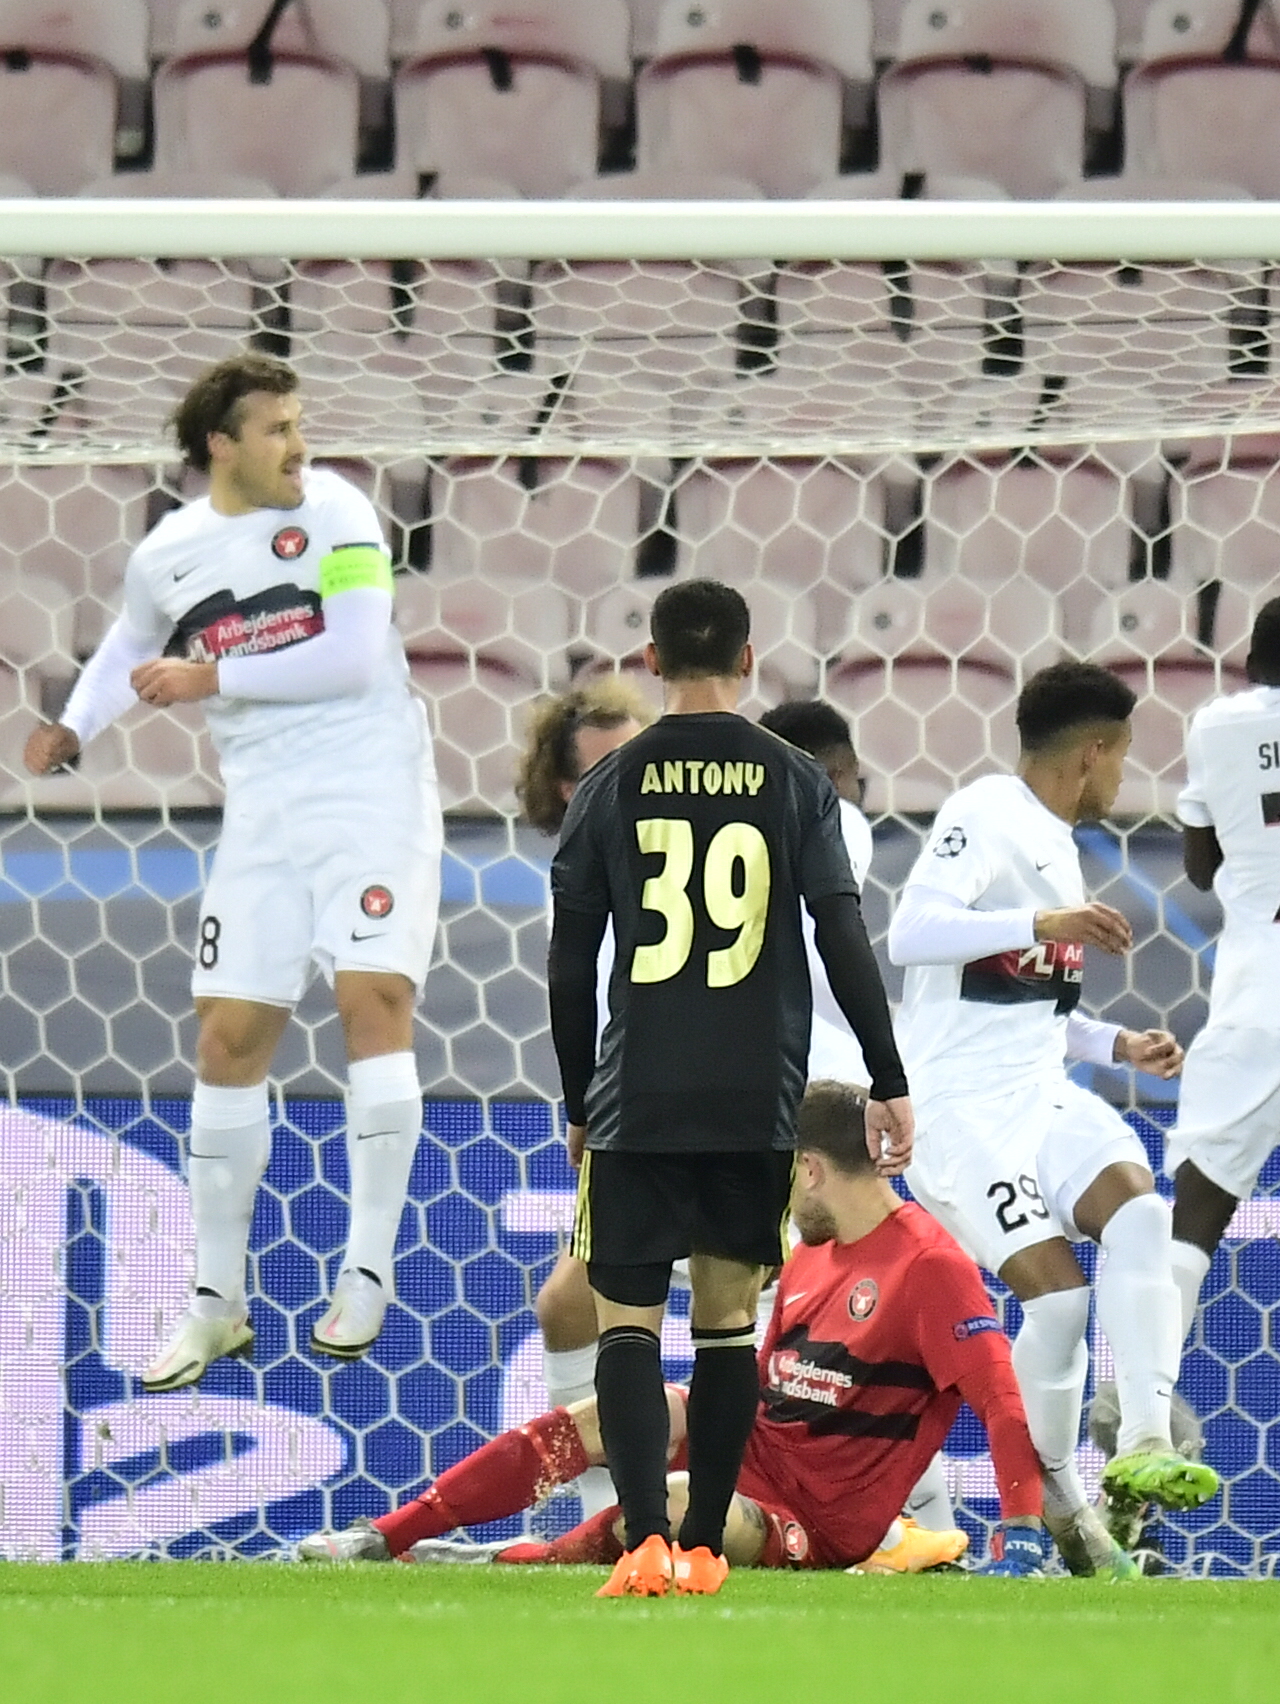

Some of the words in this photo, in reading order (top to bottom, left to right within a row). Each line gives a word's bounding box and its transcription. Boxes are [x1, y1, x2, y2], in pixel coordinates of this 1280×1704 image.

[218, 604, 315, 643] Arbejdernes
[220, 623, 308, 659] Landsbank
[640, 760, 765, 796] ANTONY
[630, 818, 770, 988] 39
[200, 916, 221, 971] 8
[986, 1173, 1050, 1234] 29
